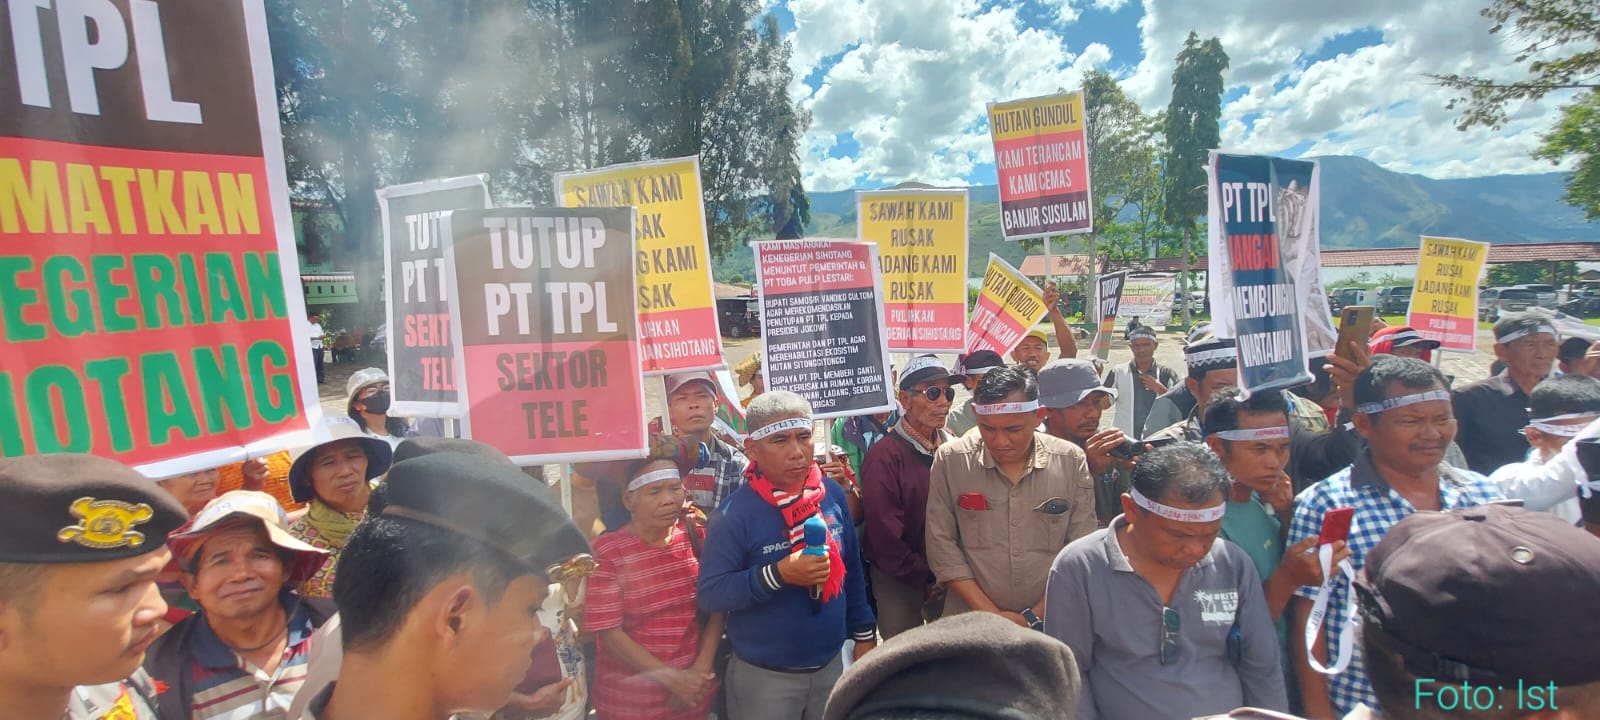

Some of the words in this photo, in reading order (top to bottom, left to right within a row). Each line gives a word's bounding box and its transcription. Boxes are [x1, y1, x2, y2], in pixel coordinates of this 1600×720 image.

[993, 109, 1031, 133] HUTAN
[1033, 103, 1077, 128] GUNDUL
[997, 148, 1025, 170] KAMI
[1025, 140, 1081, 166] TERANCAM
[576, 179, 633, 208] SAWAH
[635, 173, 683, 204] KAMI
[1009, 173, 1037, 195] KAMI
[1039, 170, 1072, 190] CEMAS
[0, 158, 260, 235] MATKAN
[1221, 182, 1243, 223] PT
[1247, 182, 1276, 223] TPL
[870, 201, 914, 221] SAWAH
[919, 200, 954, 221] KAMI
[1004, 207, 1040, 230] BANJIR
[1042, 200, 1086, 225] SUSULAN
[405, 213, 442, 252] TUT
[483, 216, 606, 270] TUTUP
[891, 228, 934, 247] RUSAK
[761, 241, 781, 252] KAMI
[762, 252, 813, 264] KENEGERIAN
[815, 250, 853, 260] SIHOTANG
[1426, 243, 1456, 258] SAWAH
[652, 245, 698, 274] KAMI
[763, 265, 807, 276] MENUNTUT
[810, 261, 858, 272] PEMERINTAH
[922, 254, 957, 274] KAMI
[402, 259, 428, 304] PT
[764, 278, 774, 288] PT
[776, 277, 797, 287] TOBA
[800, 275, 819, 285] PULP
[890, 281, 934, 301] RUSAK
[1417, 279, 1454, 296] LADANG
[0, 251, 289, 342] EGERIAN
[639, 283, 676, 309] SAK
[765, 298, 788, 308] BUPATI
[789, 296, 819, 306] SAMOSIR
[821, 293, 847, 303] VANDIKO
[983, 267, 1015, 299] UTAN
[1006, 286, 1040, 321] GUNDUL
[484, 282, 533, 336] PT
[544, 280, 618, 335] TPL
[785, 303, 851, 316] MEREKOMENDASIKAN
[640, 319, 680, 339] LIHKAN
[767, 316, 804, 327] PENUTUPAN
[805, 315, 814, 323] PT
[816, 314, 828, 323] TPL
[830, 311, 853, 321] KEPADA
[404, 313, 451, 348] SEKT
[767, 327, 799, 337] PRESIDEN
[800, 323, 827, 333] JOKOWI
[663, 338, 716, 359] SIHOTANG
[769, 341, 811, 352] PEMERINTAH
[812, 339, 827, 348] DAN
[828, 338, 836, 347] PT
[837, 337, 849, 346] TPL
[769, 351, 824, 362] MEREHABILITASI
[825, 345, 859, 357] EKOSISTIM
[1239, 329, 1293, 367] WARTAWAN
[420, 356, 458, 391] TEL
[496, 350, 608, 391] SEKTOR
[770, 361, 792, 372] HUTAN
[771, 375, 797, 385] SUPAYA
[799, 373, 808, 382] PT
[810, 372, 822, 381] TPL
[824, 369, 855, 379] MEMBERI
[790, 381, 828, 393] KERUSAKAN
[857, 375, 882, 385] KORBAN
[0, 339, 299, 457] OTANG
[521, 398, 588, 440] TELE
[762, 540, 791, 555] SPAC
